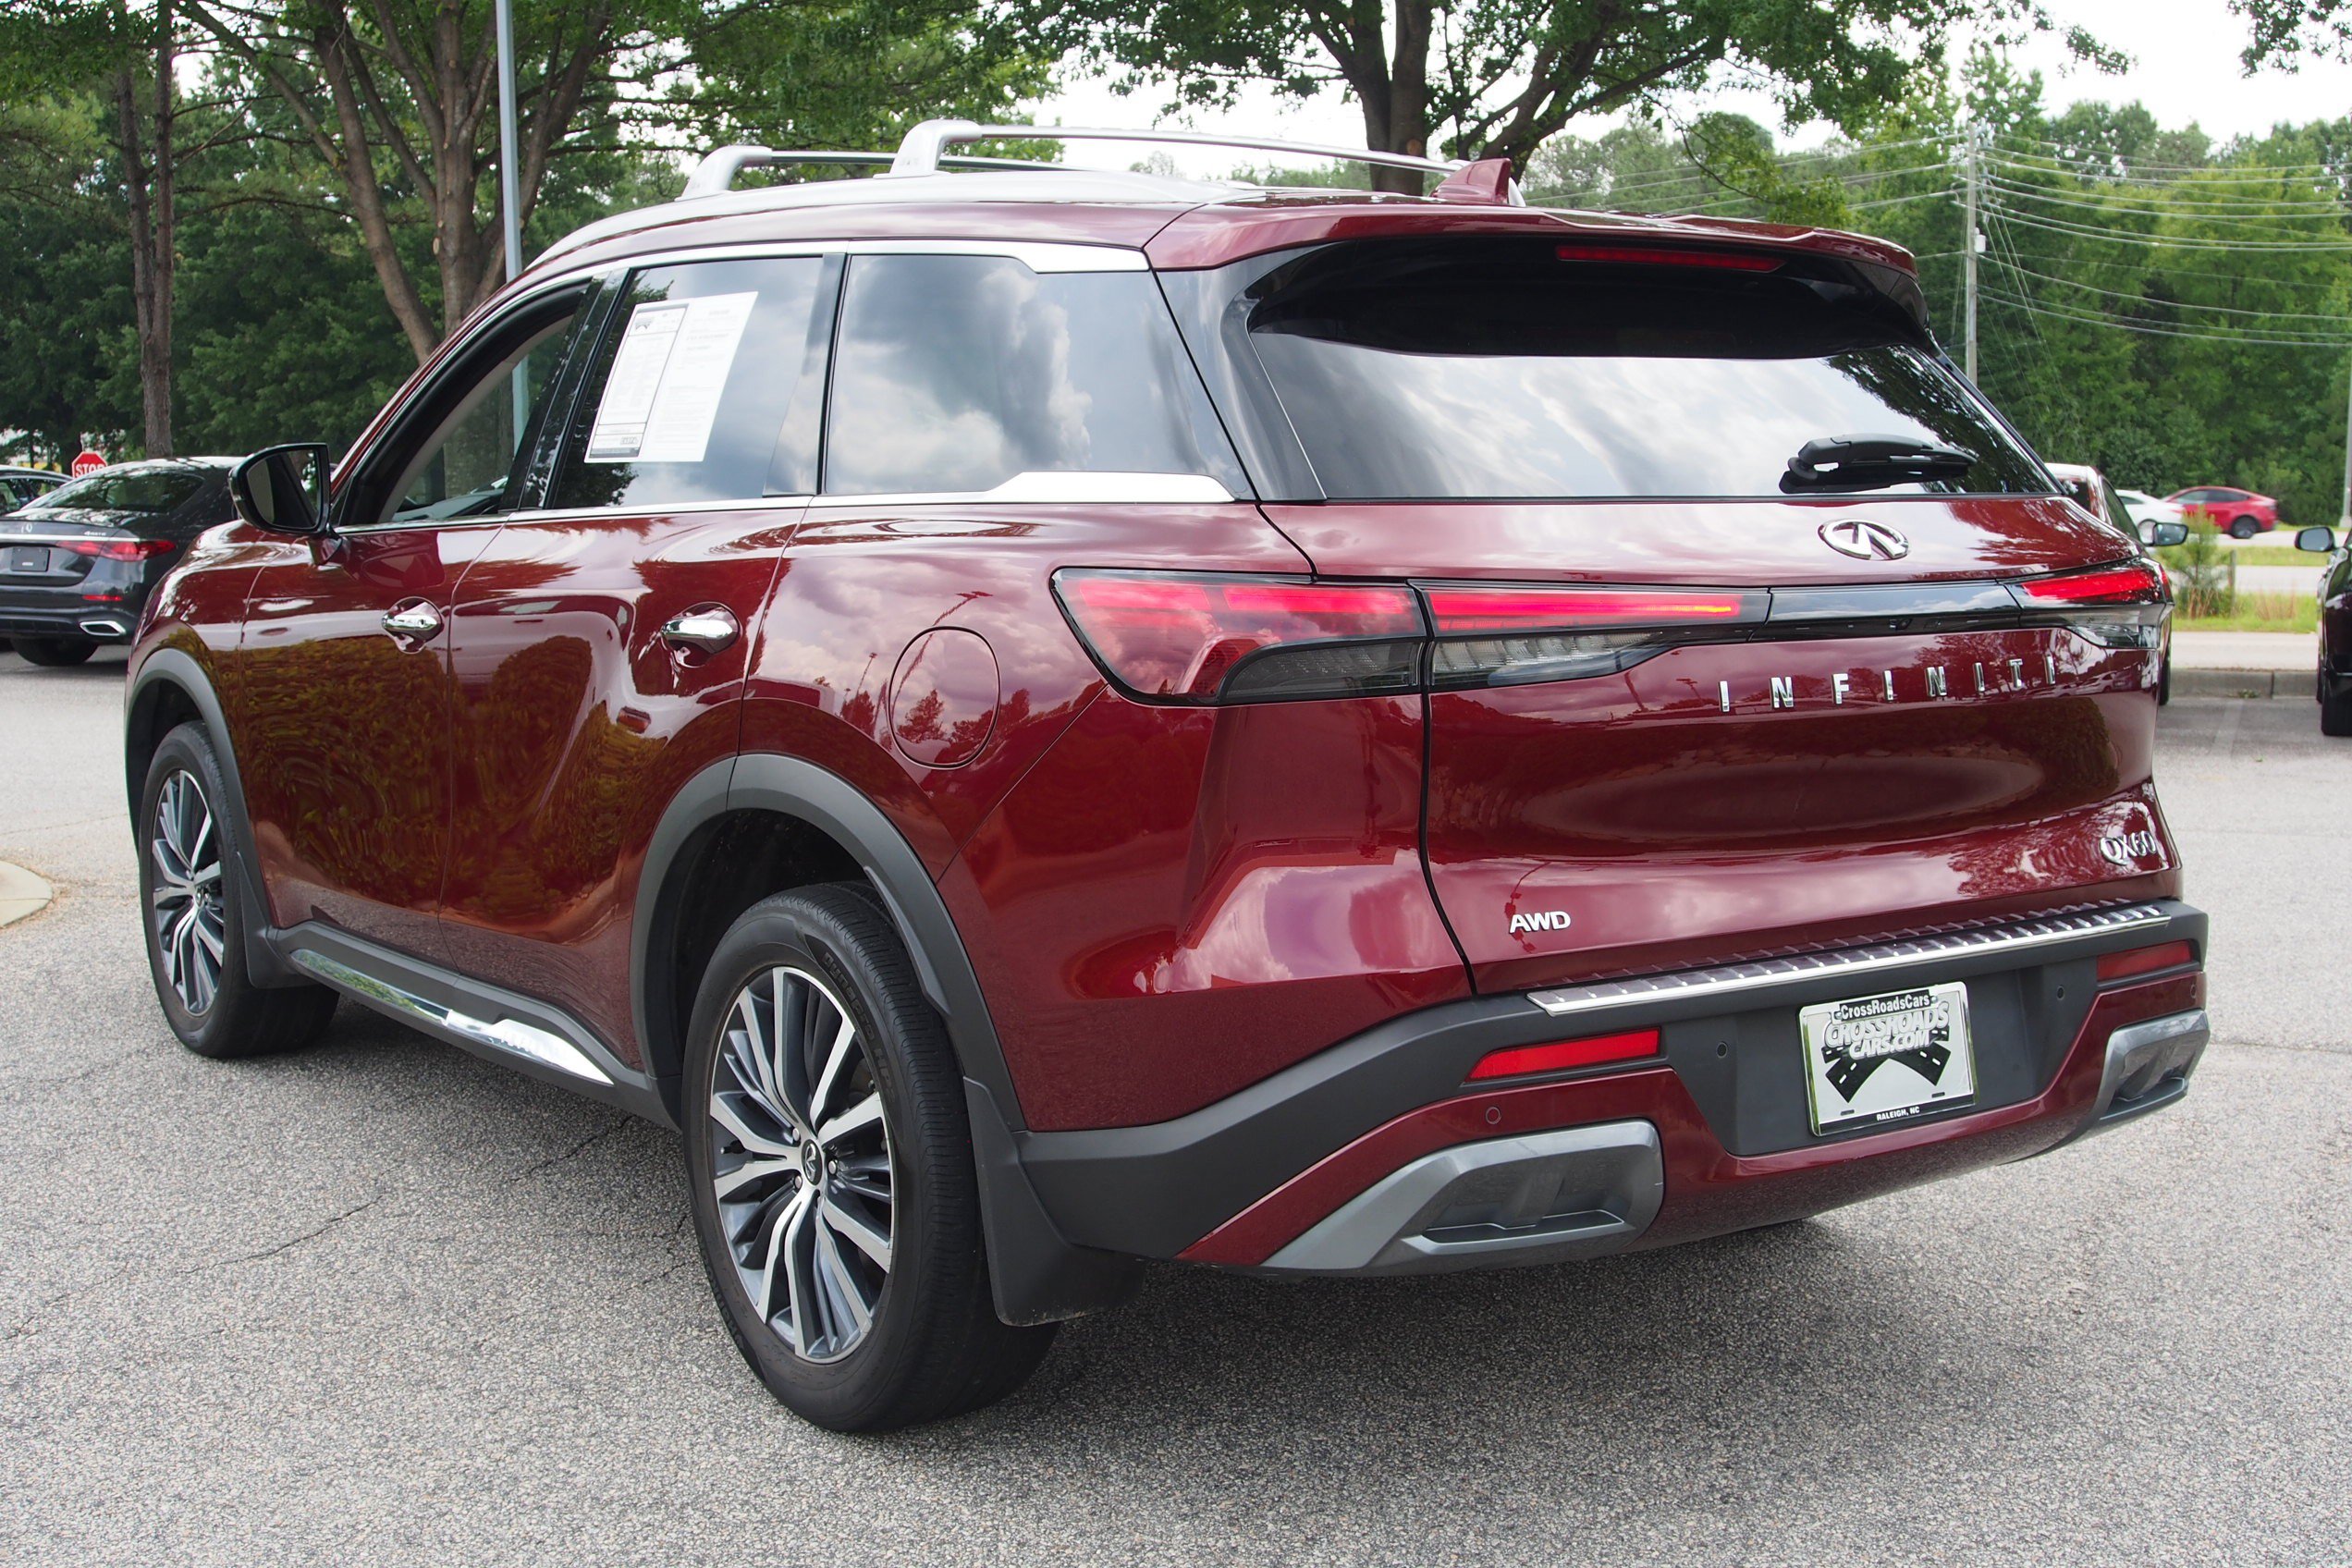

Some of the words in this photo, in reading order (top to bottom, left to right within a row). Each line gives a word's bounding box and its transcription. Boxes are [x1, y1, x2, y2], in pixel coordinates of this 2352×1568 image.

[1719, 655, 2055, 712] INFINITI
[2099, 830, 2157, 865] QX60
[1510, 911, 1571, 934] AWD
[1840, 993, 1930, 1021] CrossRoadsCars
[1876, 1108, 1908, 1121] RALEIGH,
[1909, 1106, 1920, 1116] NC
